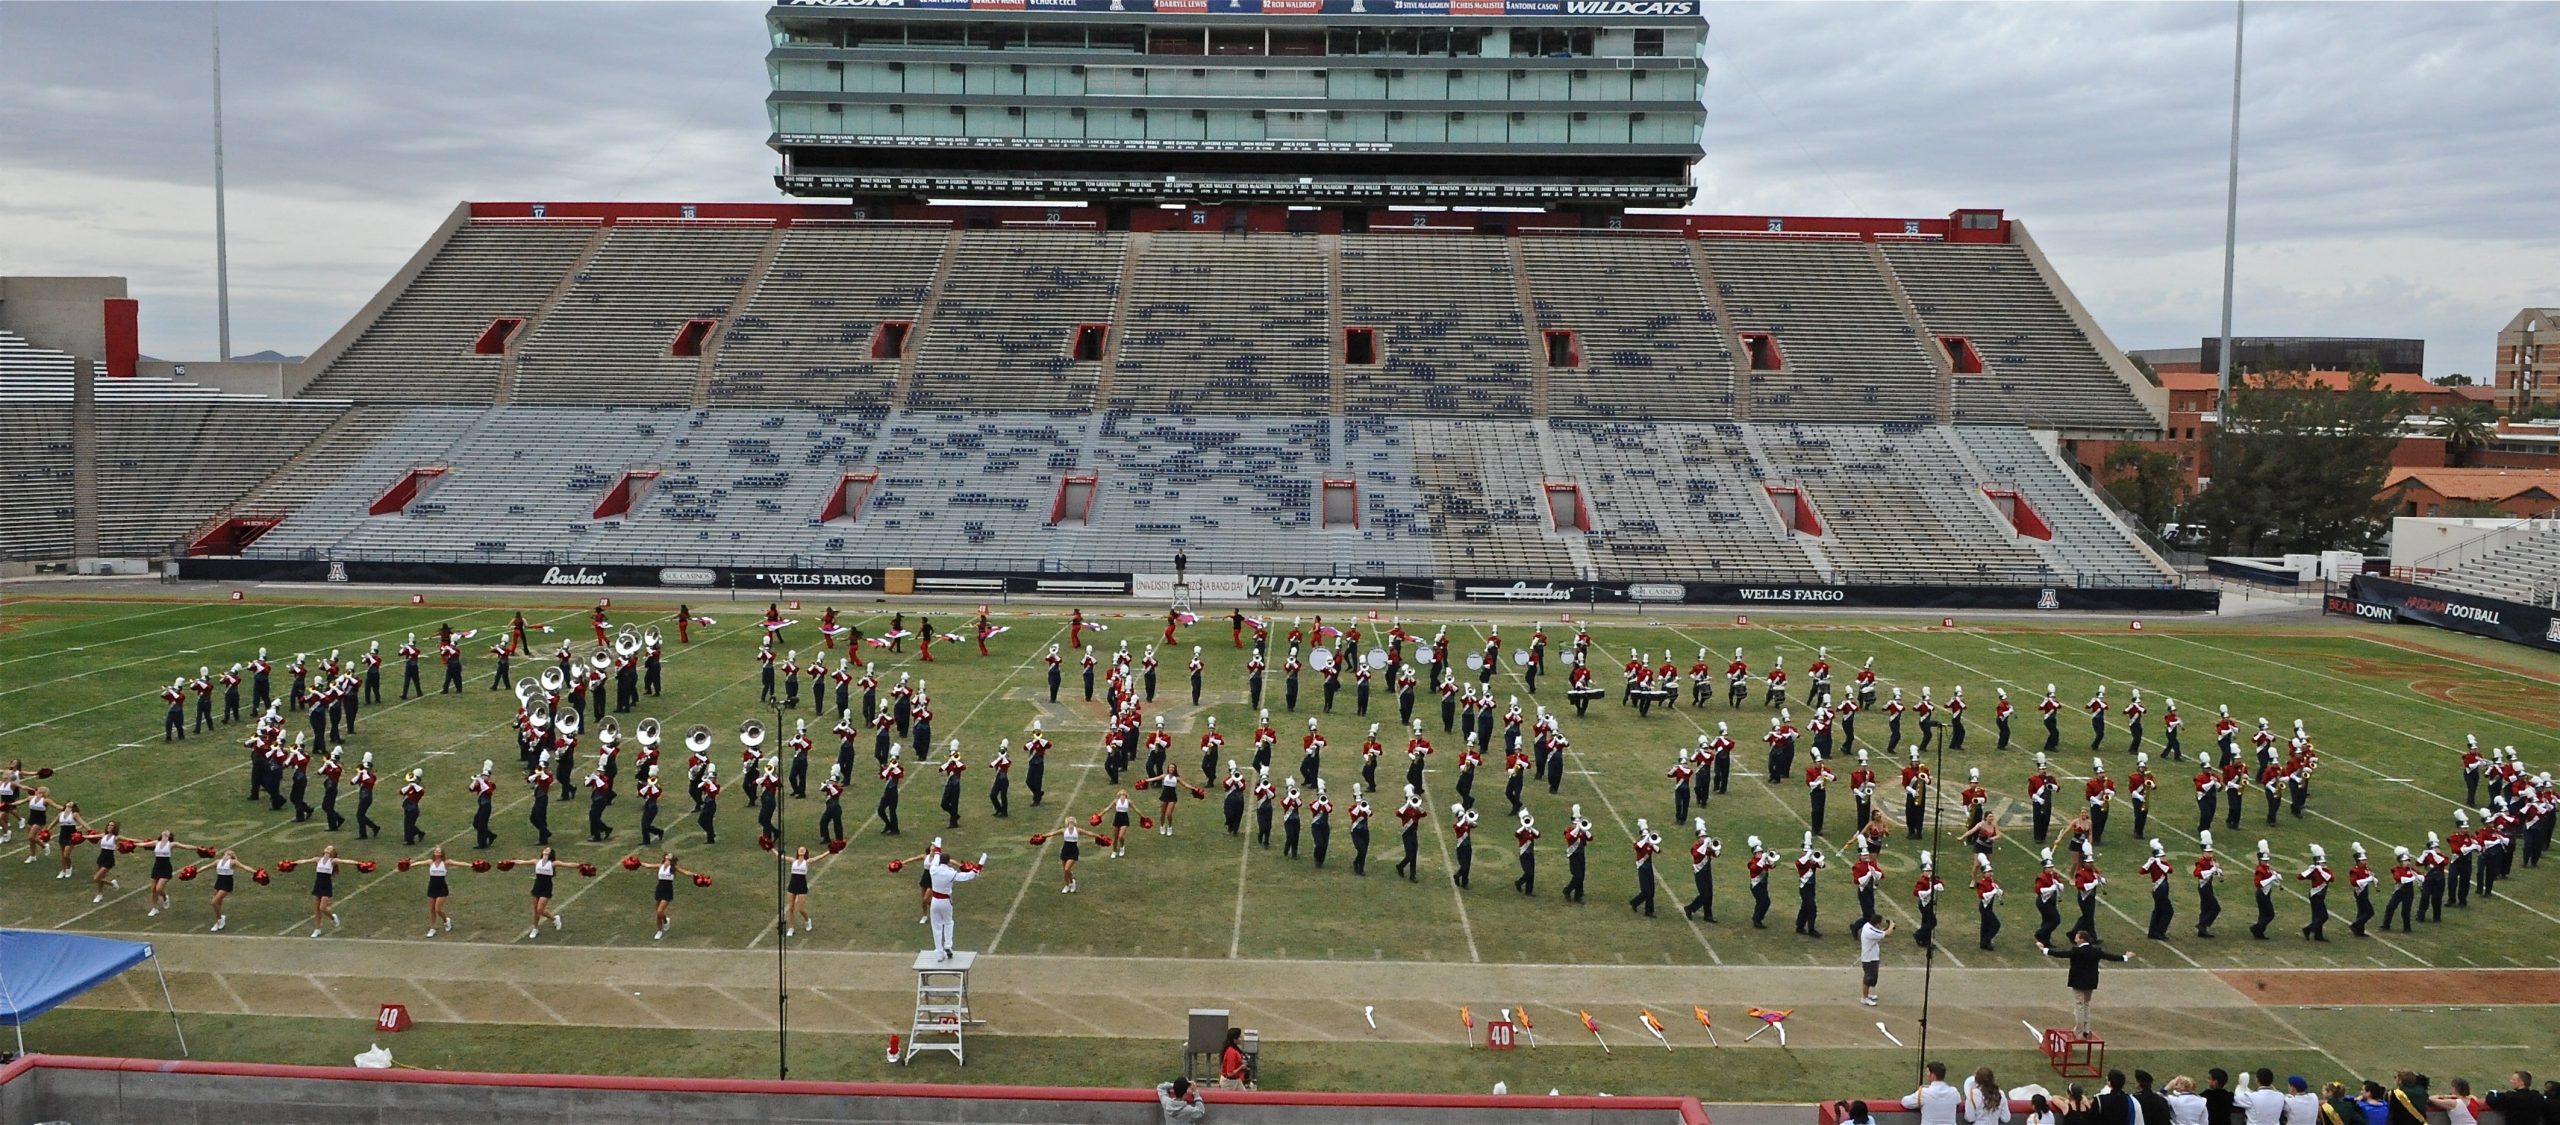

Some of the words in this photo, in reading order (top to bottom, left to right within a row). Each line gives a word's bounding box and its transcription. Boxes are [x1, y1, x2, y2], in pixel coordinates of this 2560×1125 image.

[1567, 2, 1693, 15] WILDCATS
[534, 209, 544, 218] 17
[683, 209, 695, 218] 18
[855, 211, 865, 220] 19
[1047, 213, 1059, 222] 20
[1194, 214, 1205, 223] 21
[1413, 218, 1426, 226] 22
[1609, 220, 1621, 229] 23
[1769, 223, 1781, 232] 24
[1906, 225, 1918, 234] 25
[541, 567, 607, 585] Bashas'
[769, 575, 821, 585] WELLS
[824, 575, 873, 586] FARGO
[1136, 581, 1169, 591] UNIVERSITY
[1211, 581, 1231, 591] BAND
[1231, 581, 1244, 591] DAY
[1740, 590, 1791, 601] WELLS
[1795, 590, 1844, 601] FARGO
[379, 1008, 398, 1028] 40
[1491, 1025, 1510, 1046] 40
